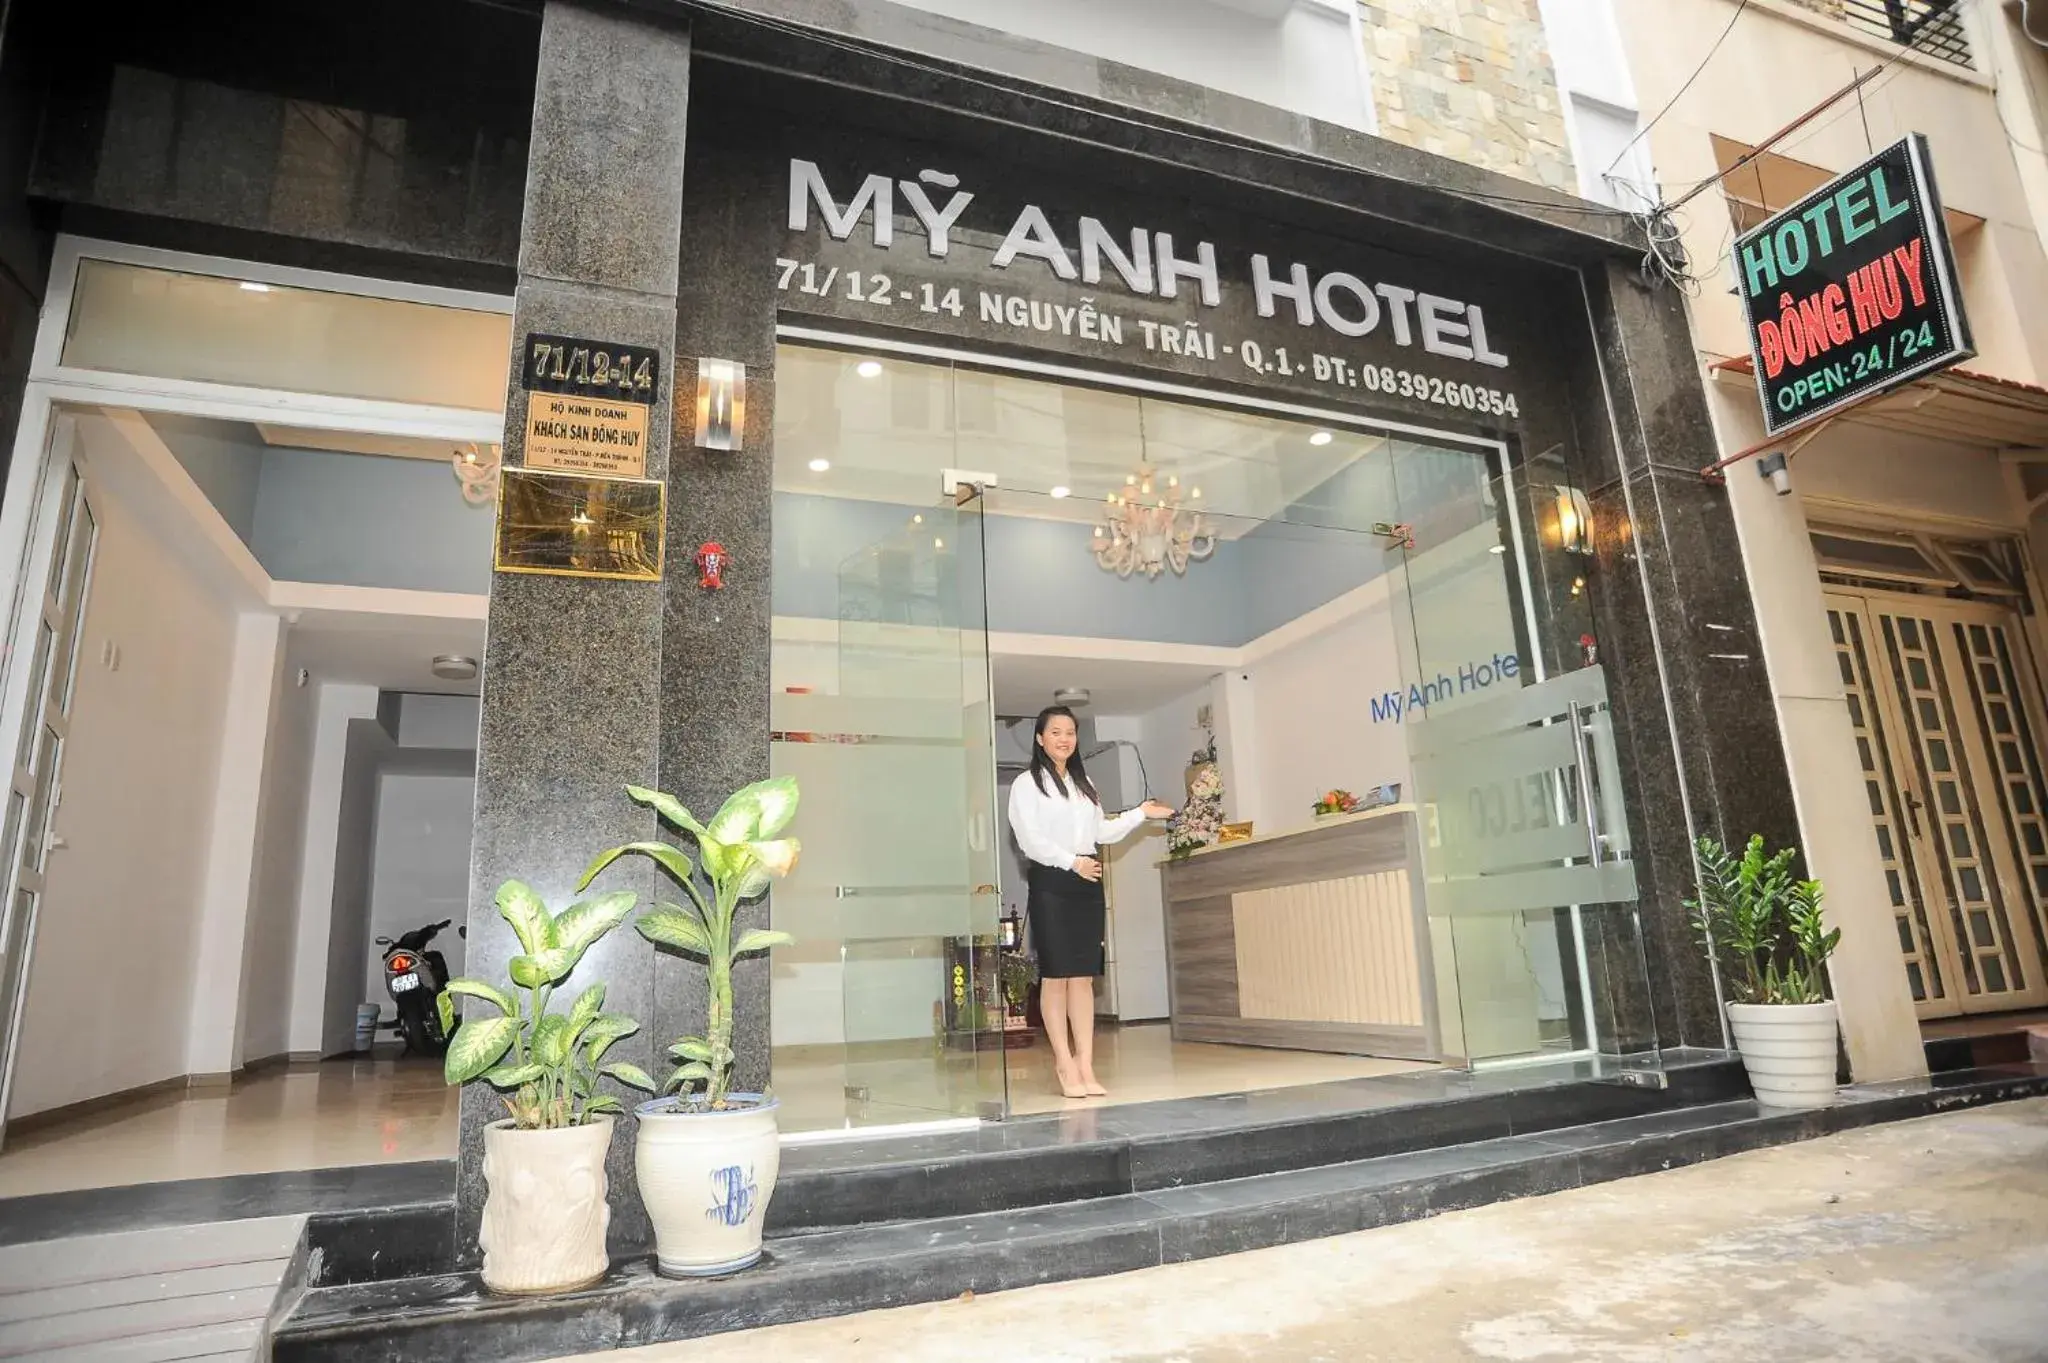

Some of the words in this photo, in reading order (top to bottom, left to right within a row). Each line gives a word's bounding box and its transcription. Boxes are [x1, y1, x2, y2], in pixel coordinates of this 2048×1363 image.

[788, 158, 974, 257] MỸ
[991, 204, 1220, 307] ANH
[1251, 253, 1509, 368] HOTEL
[1743, 167, 1909, 297] HOTEL
[979, 295, 1123, 345] NGUYỄN
[1138, 320, 1216, 361] TRÃI
[1362, 363, 1520, 420] 0839260354
[1757, 282, 1854, 380] ĐÔNG
[1846, 237, 1927, 336] HUY
[533, 342, 652, 390] 71/12-14
[550, 400, 565, 416] HỘ
[568, 404, 591, 416] KINH
[594, 407, 628, 421] DOANH
[533, 417, 568, 439] KHÁCH
[570, 424, 590, 444] SẠN
[620, 429, 641, 447] HUY
[1370, 691, 1403, 724] Mỹ
[1407, 674, 1454, 712] Anh
[1458, 653, 1520, 694] Hote
